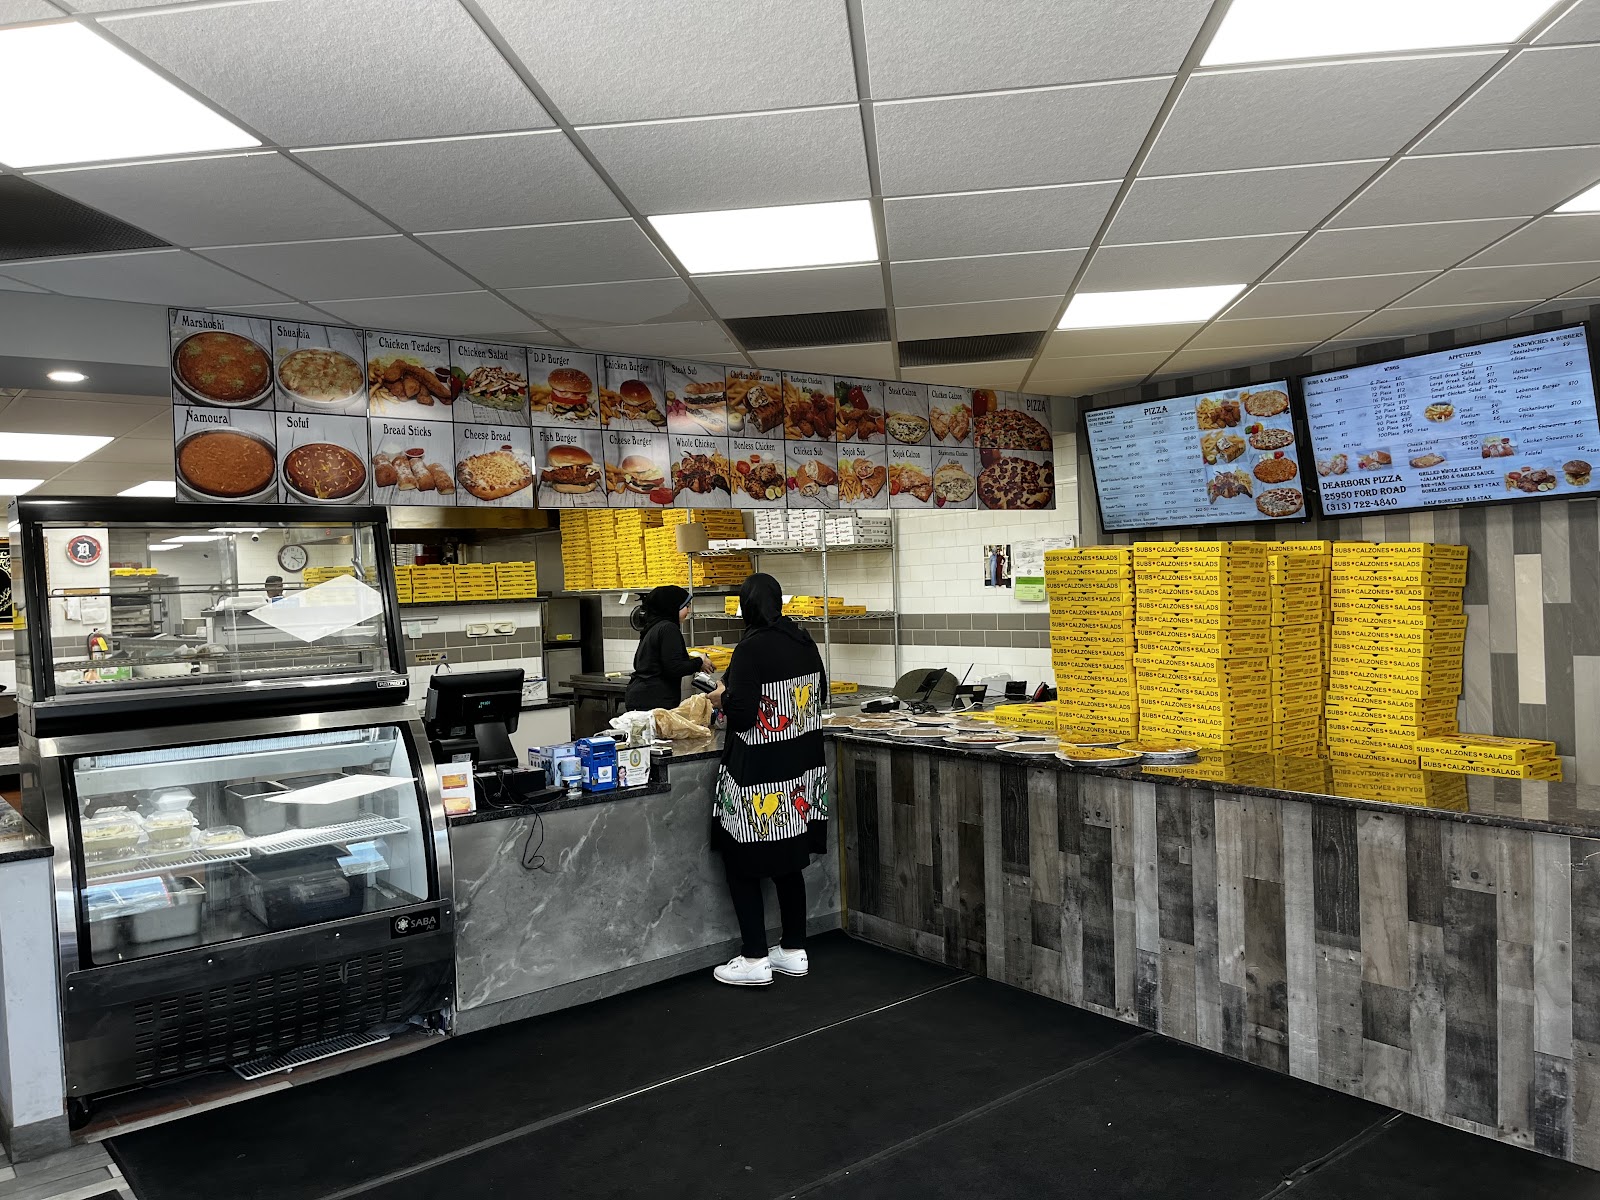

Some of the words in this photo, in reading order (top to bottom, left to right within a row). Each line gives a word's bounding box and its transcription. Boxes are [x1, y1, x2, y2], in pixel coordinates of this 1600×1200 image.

[181, 315, 225, 331] Marshoshi
[277, 325, 310, 339] Shuaibia
[378, 337, 409, 350] Chicken
[411, 340, 441, 353] Tenders
[1510, 346, 1545, 355] Cheeseburger
[458, 345, 486, 358] Chicken
[488, 348, 509, 360] Salad
[1449, 351, 1481, 360] APPETIZERS
[534, 353, 546, 362] D.P
[548, 354, 570, 366] Burger
[604, 358, 628, 371] Chicken
[629, 361, 649, 374] Burger
[671, 365, 686, 375] Steak
[687, 367, 697, 375] Sub
[1513, 366, 1542, 374] Hamburger
[730, 370, 748, 380] Chicken
[931, 389, 947, 399] Chicken
[1026, 399, 1047, 413] PIZZA
[1144, 406, 1168, 415] PIZZA
[186, 410, 229, 424] Namoura
[383, 424, 405, 435] Bread
[408, 425, 432, 437] Sticks
[464, 429, 489, 440] Cheese
[491, 431, 511, 441] Bread
[540, 431, 554, 442] Fish
[556, 432, 577, 444] Burger
[609, 434, 630, 445] Cheese
[632, 435, 652, 447] Burger
[676, 437, 693, 447] Whole
[694, 438, 716, 449] Chicken
[755, 441, 775, 451] Chicken
[793, 446, 812, 456] Chicken
[813, 447, 823, 456] Sub
[856, 447, 866, 456] Sub
[1322, 478, 1371, 489] DEARBORN
[1373, 474, 1402, 484] PIZZA
[1324, 491, 1352, 501] 25950
[1354, 488, 1378, 497] FORD
[1380, 485, 1406, 494] ROAD
[1326, 502, 1351, 511] (313)
[1354, 498, 1397, 509] 722-4840
[1349, 696, 1382, 705] CALZONES
[1387, 699, 1414, 708] SALADS
[1107, 715, 1129, 723] SALADS
[1161, 713, 1193, 722] CALZONES
[1198, 718, 1222, 726] SALADS
[1440, 749, 1478, 757] CALZONES
[1484, 752, 1513, 761] SALADS
[1447, 763, 1485, 772] CALZONES
[1491, 767, 1520, 776] SALADS
[411, 916, 436, 927] SABA
